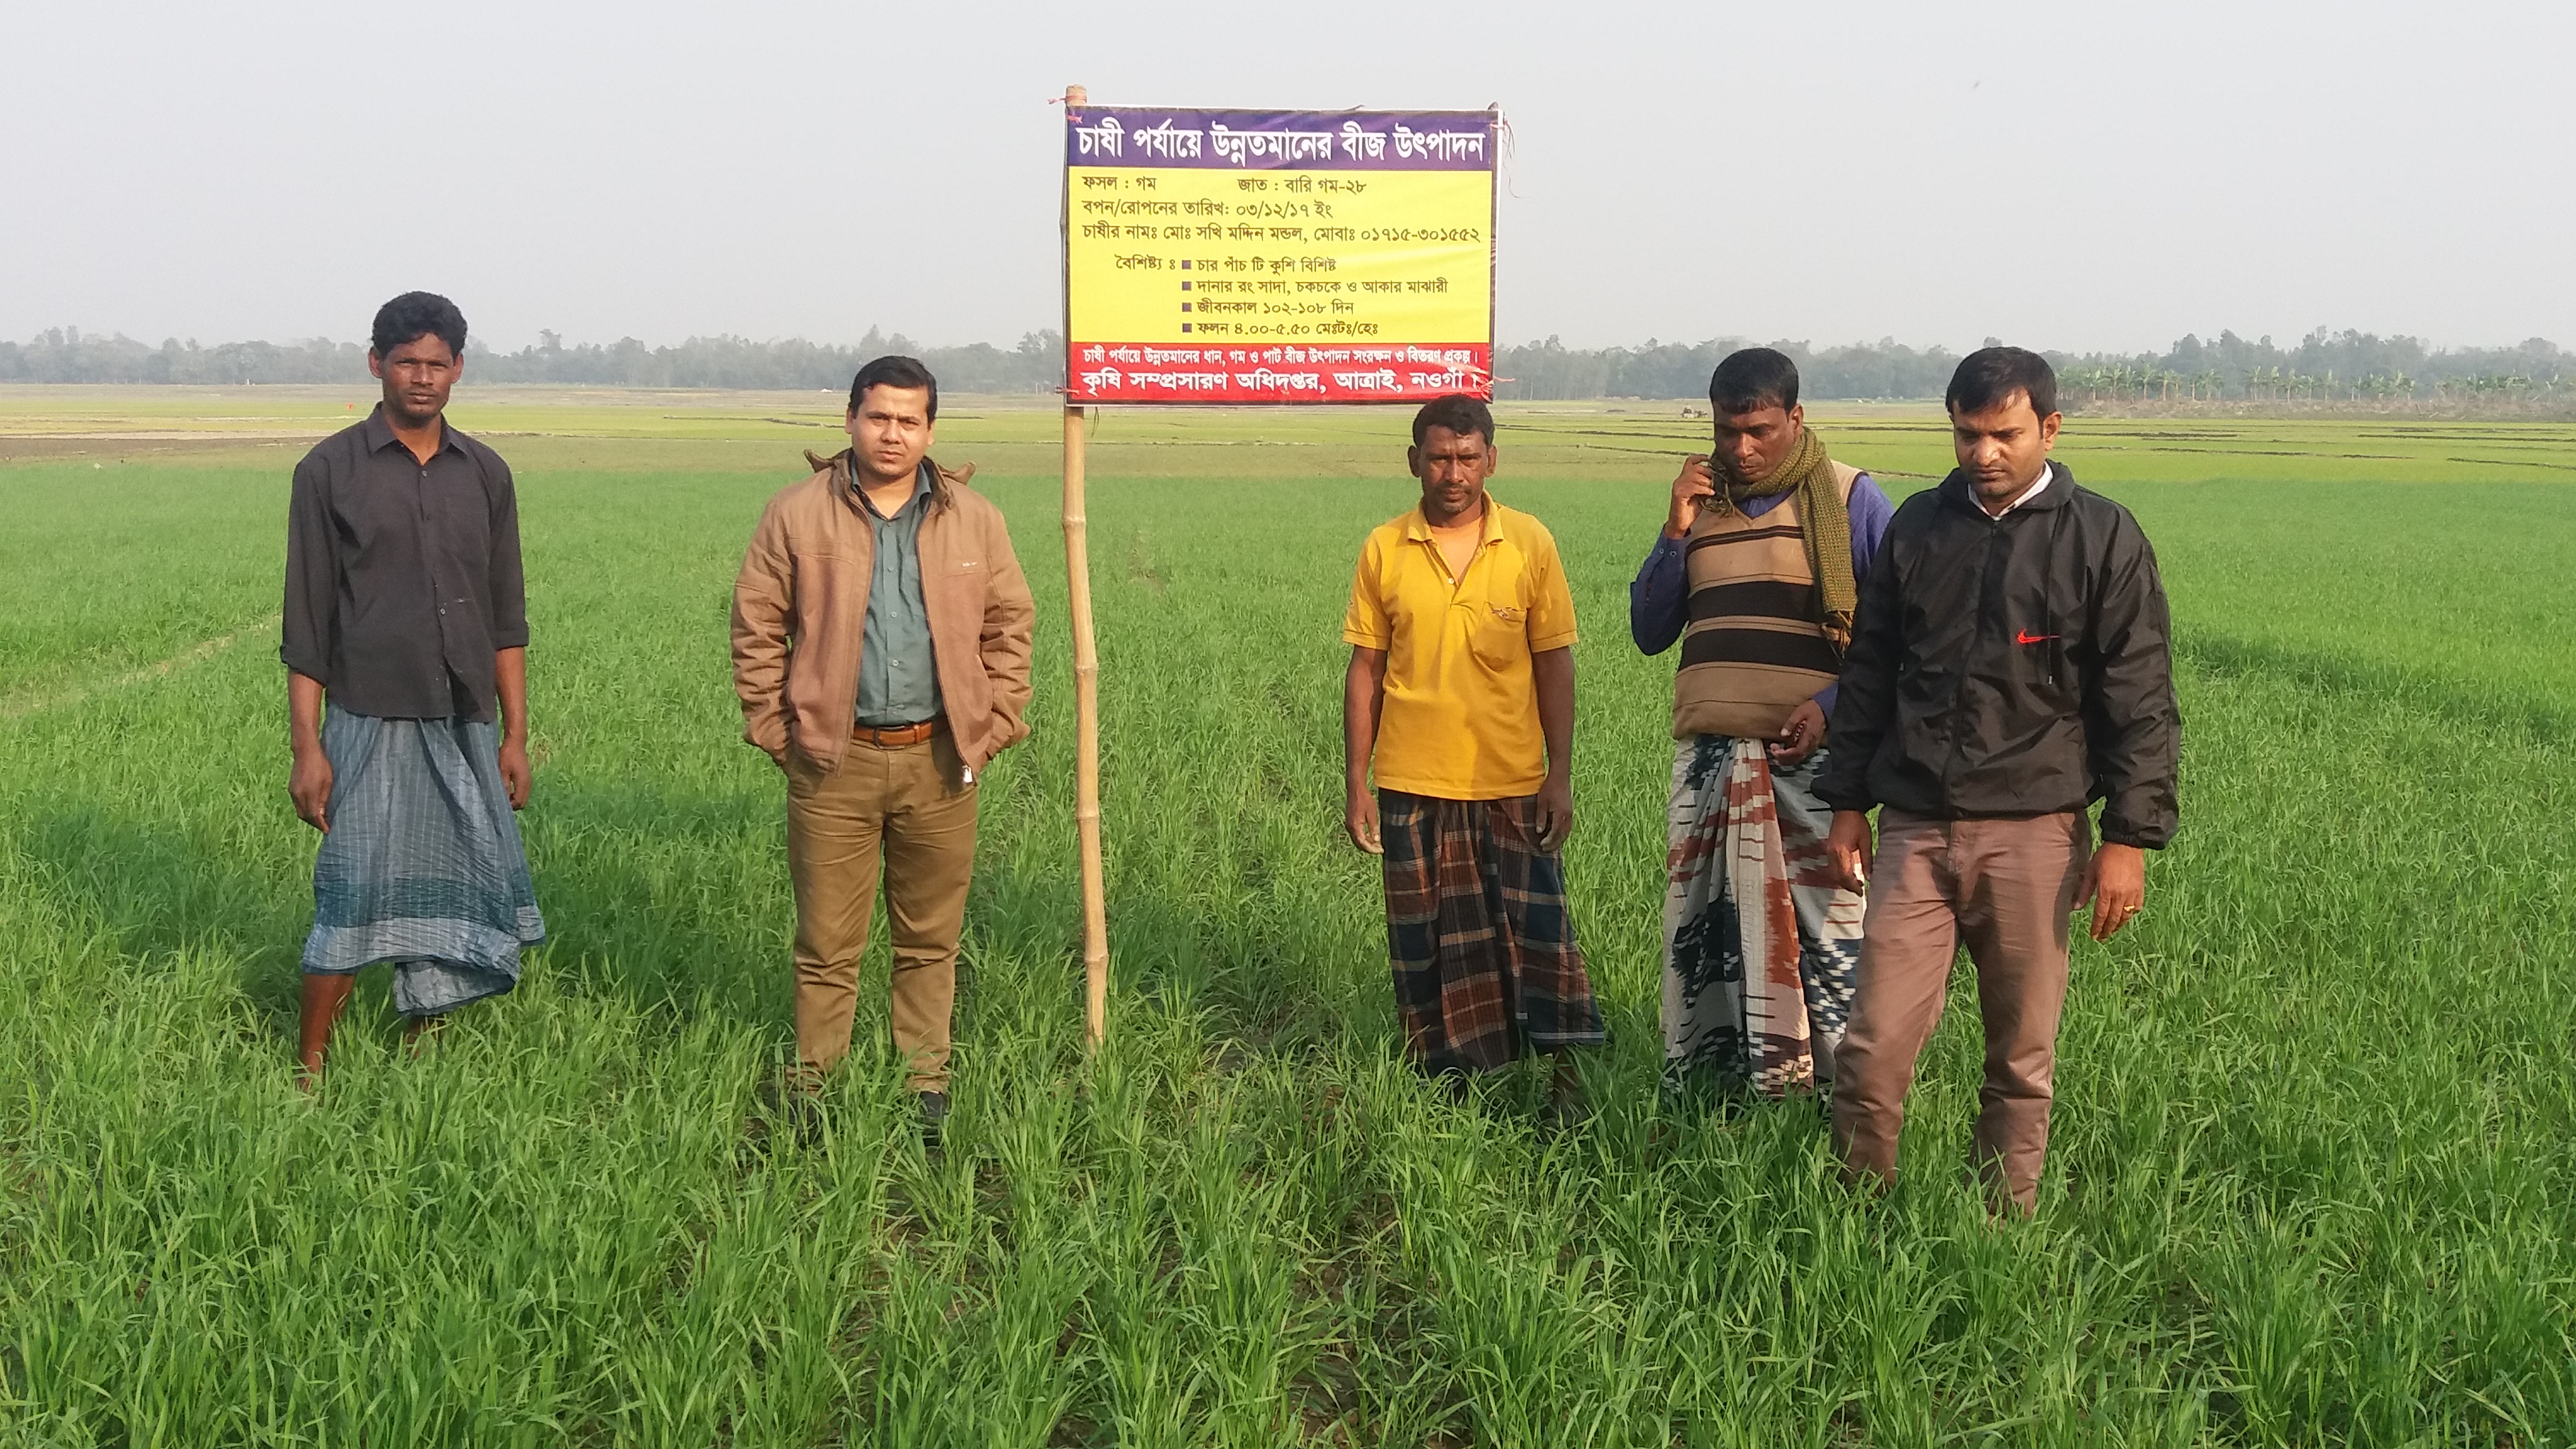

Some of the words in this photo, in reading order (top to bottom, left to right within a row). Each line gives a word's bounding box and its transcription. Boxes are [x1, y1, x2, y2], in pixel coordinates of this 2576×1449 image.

[1075, 117, 1125, 158] চাষী
[1133, 118, 1204, 159] পর্যায়ে
[1209, 120, 1334, 167] উন্নতমানের
[1339, 121, 1387, 161] বীজ
[1392, 122, 1486, 161] উৎপাদন
[1082, 176, 1118, 190] ফসল
[1136, 175, 1157, 191] গম
[1237, 177, 1268, 192] জাত
[1284, 175, 1312, 193] বারি
[1317, 178, 1367, 195] গম-২৮
[1081, 198, 1177, 217] বপন/রোপনের
[1236, 201, 1308, 218] ০৩/১২/১৭
[1314, 199, 1333, 218] ইং
[1083, 220, 1120, 239] চাষীর
[1164, 225, 1191, 239] মোঃ
[1226, 223, 1264, 242] মদ্দিন
[1269, 226, 1307, 243] মন্ডল,
[1314, 226, 1355, 242] মোবাঃ
[1361, 227, 1480, 243] ০১৭১৫-৩০১৫৫২
[1197, 260, 1217, 271] চার
[1224, 256, 1247, 272] পাঁচ
[1251, 256, 1264, 272] টি
[1269, 256, 1295, 276] কুশি
[1299, 256, 1337, 273] বিশিষ্ট
[1196, 280, 1232, 293] দানার
[1237, 281, 1254, 294] রং
[1257, 280, 1290, 296] সাদা,
[1295, 281, 1341, 293] চকচকে
[1347, 281, 1357, 292] ও
[1362, 281, 1402, 293] আকার
[1406, 277, 1448, 293] মাঝারী
[1196, 298, 1257, 315] জীবনকাল
[1263, 302, 1326, 316] ১০২-১০৮
[1331, 299, 1354, 315] দিন
[1197, 323, 1229, 335] ফলন
[1234, 323, 1310, 336] ৪.০০-৫.৫০
[1083, 344, 1105, 364] চাষী
[1108, 345, 1141, 364] পর্যায়ে
[1143, 346, 1200, 367] উন্নতমানের
[1204, 348, 1226, 367] ধান,
[1229, 349, 1246, 364] গম
[1250, 351, 1259, 363] ও
[1262, 346, 1282, 364] পাট
[1284, 345, 1305, 364] বীজ
[1309, 347, 1350, 364] উৎপাদন
[1353, 349, 1392, 365] সংরক্ষন
[1395, 351, 1404, 363] ও
[1407, 346, 1440, 364] বিতরণ
[1080, 366, 1122, 397] কৃষি
[1128, 370, 1229, 391] সম্প্রসারণ
[1234, 368, 1326, 394] অধিদপ্তর,
[1333, 367, 1403, 393] আত্রাই,
